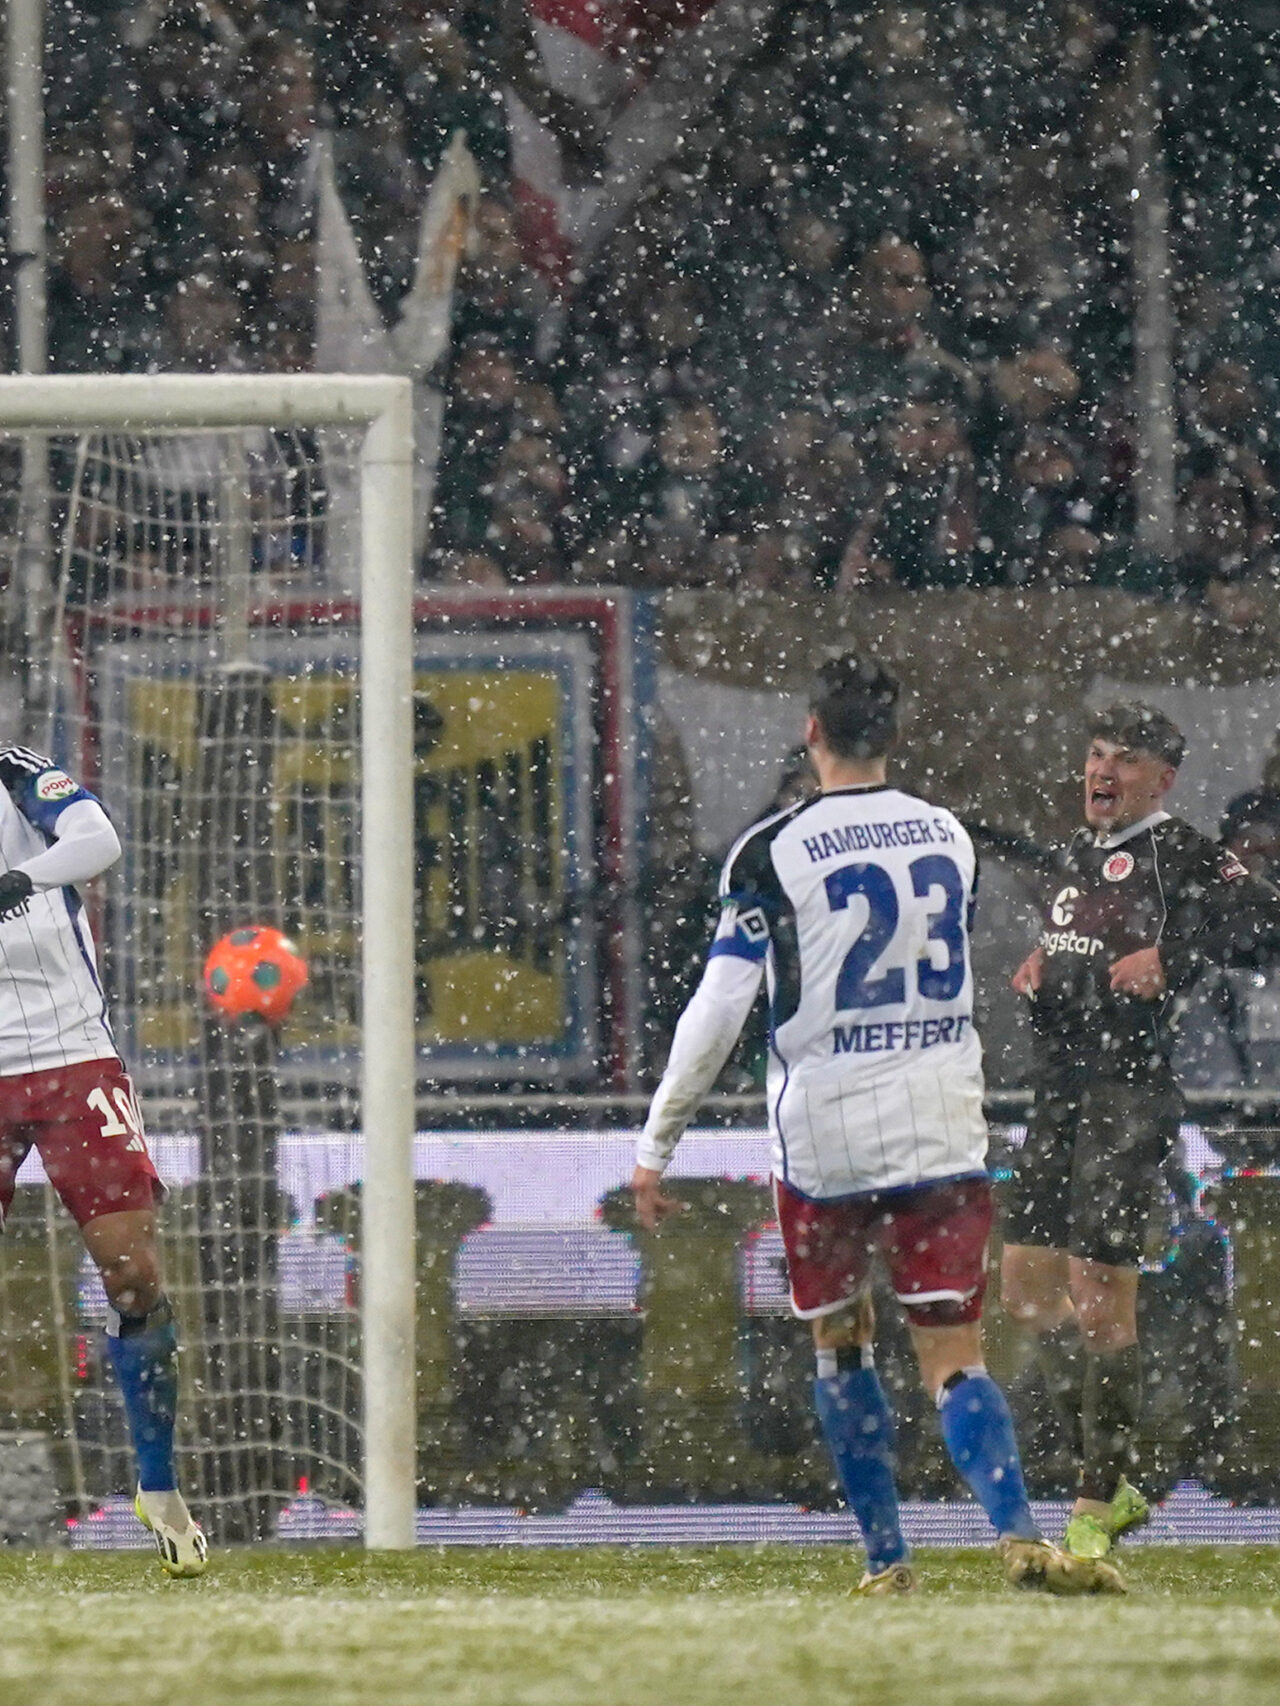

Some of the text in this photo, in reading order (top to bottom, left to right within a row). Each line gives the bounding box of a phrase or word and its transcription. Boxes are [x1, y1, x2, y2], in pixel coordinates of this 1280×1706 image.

[803, 819, 934, 863] HAMBURGER
[823, 854, 966, 1011] 23
[831, 1016, 970, 1055] MEFFERT
[86, 1086, 142, 1137] 10
